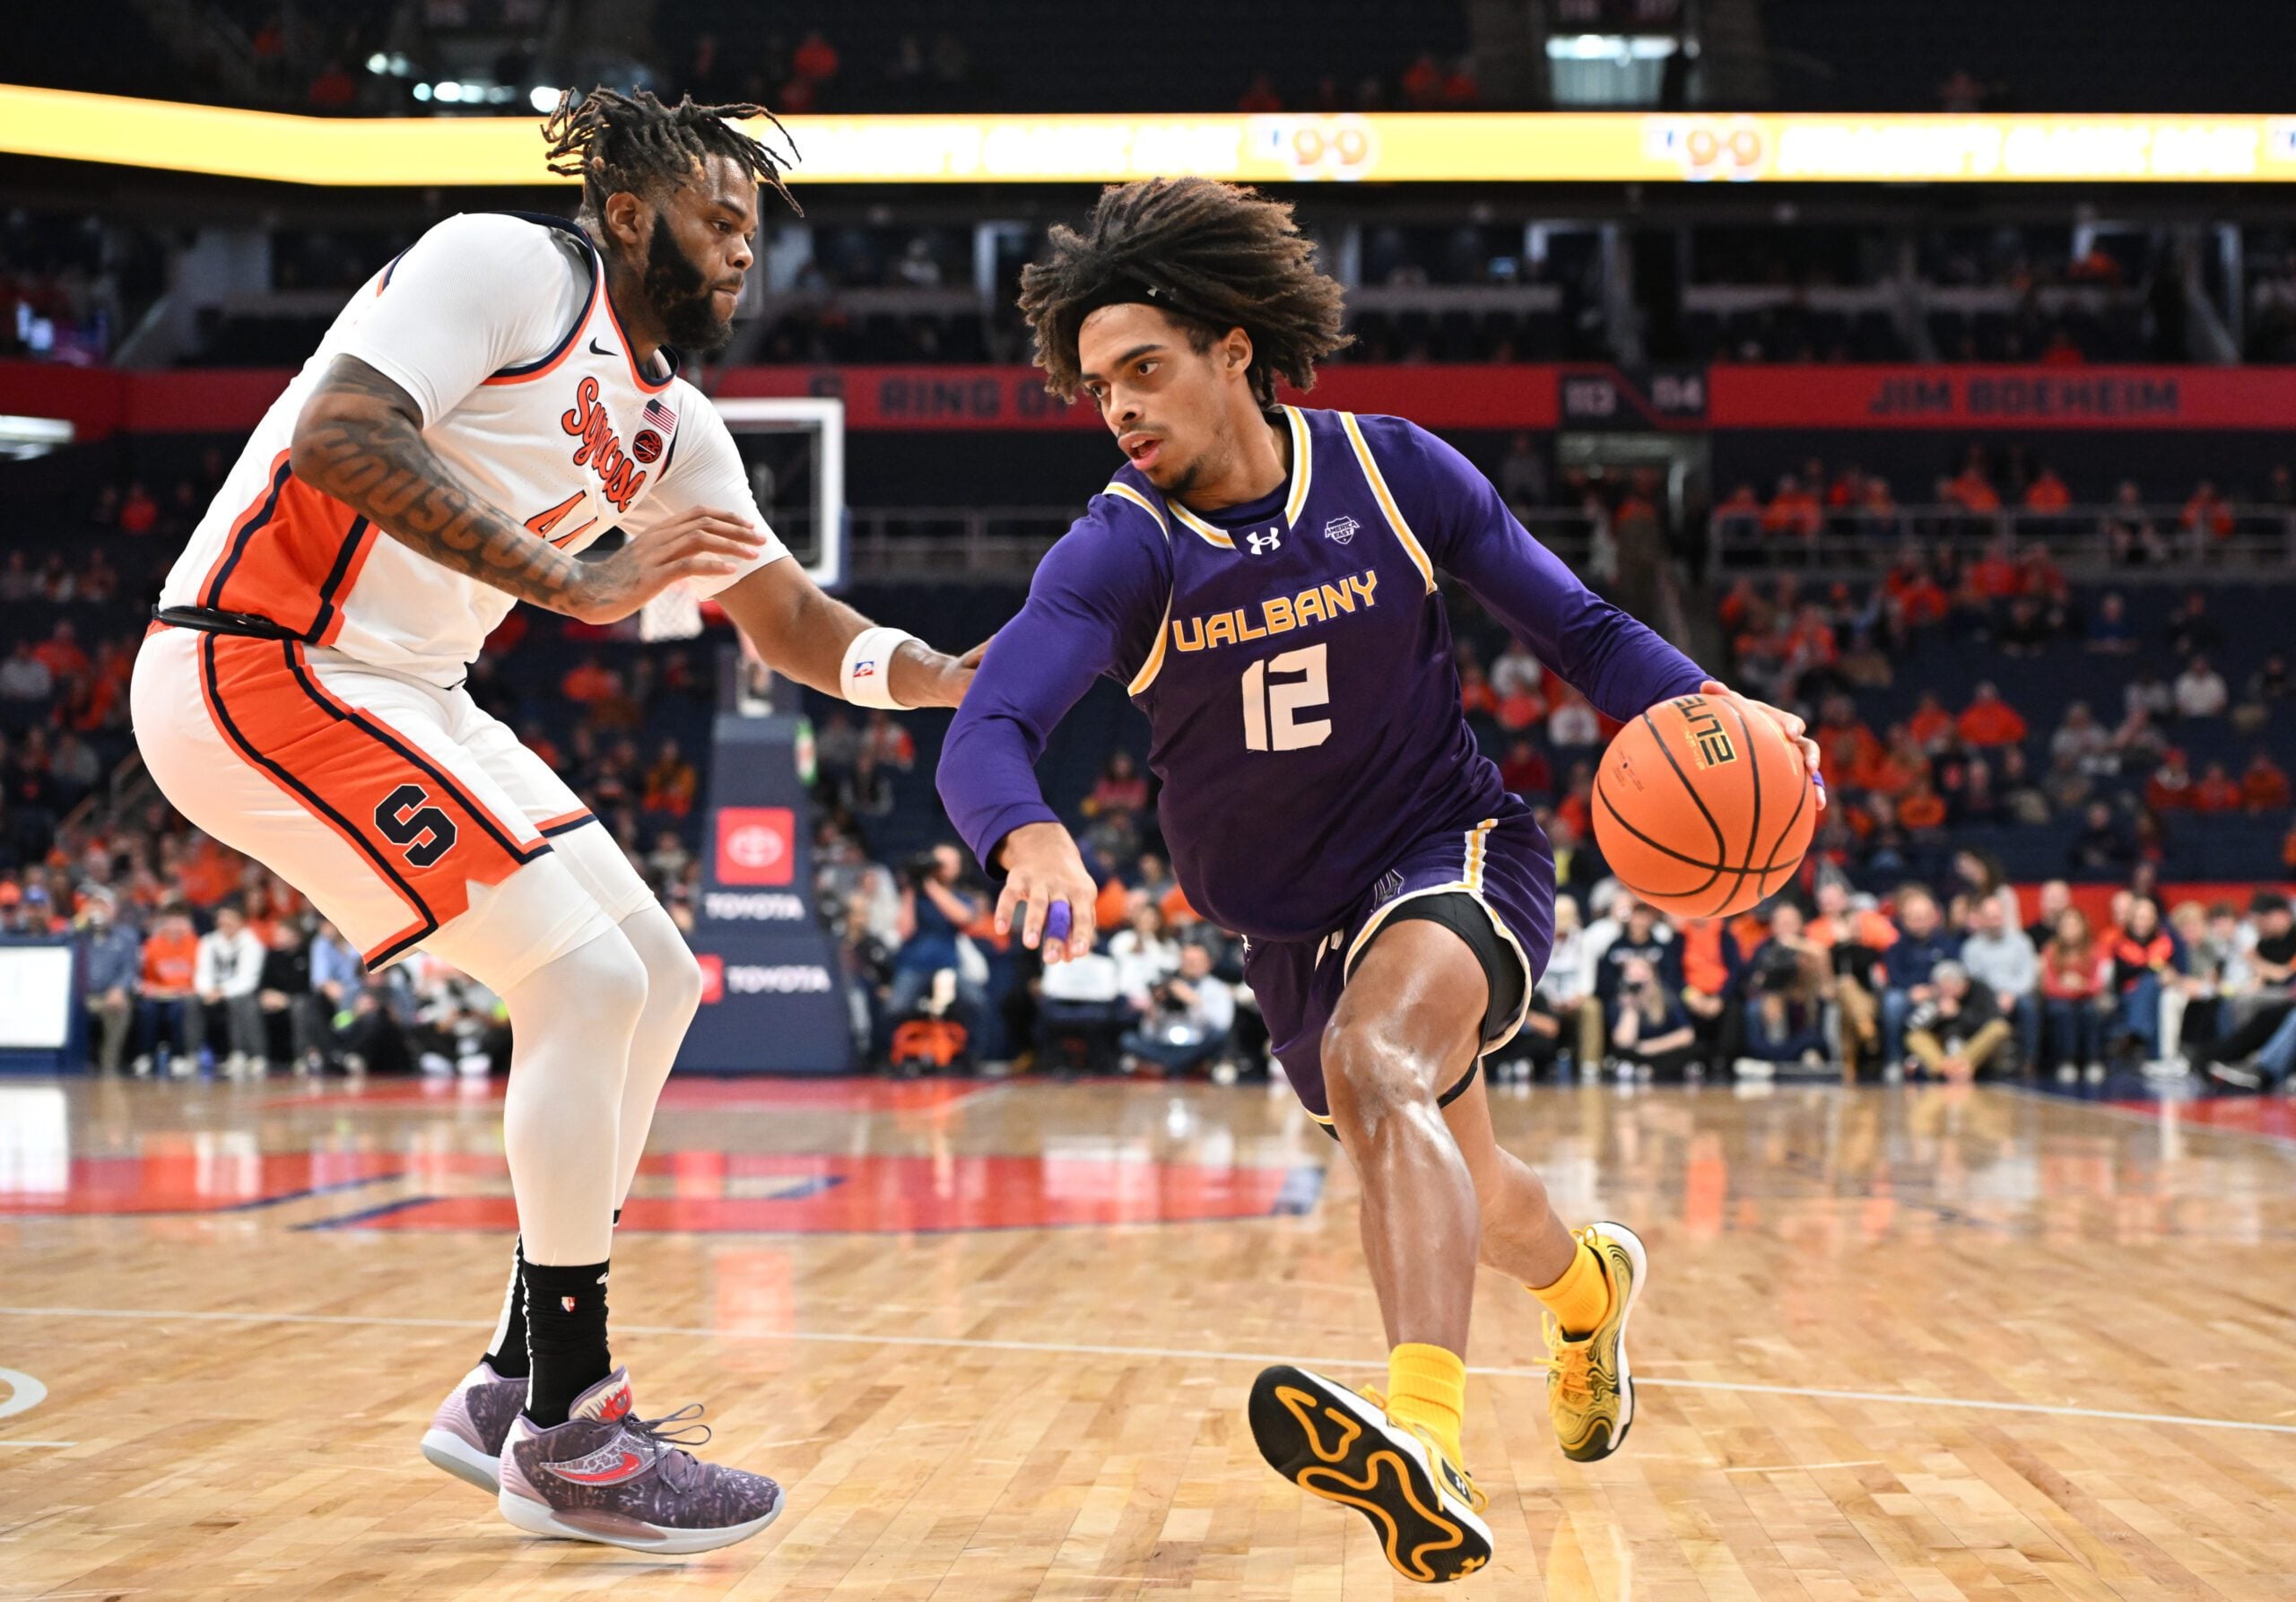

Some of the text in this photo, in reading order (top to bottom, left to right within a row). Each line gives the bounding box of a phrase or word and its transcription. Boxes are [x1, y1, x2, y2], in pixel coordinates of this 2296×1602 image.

[1871, 377, 2179, 414] JIM BOEHEIM
[1172, 570, 1378, 652] UALBANY
[1241, 642, 1332, 752] 12
[374, 783, 458, 869] S
[705, 892, 805, 920] TOYOTA
[727, 965, 831, 993] TOYOTA
